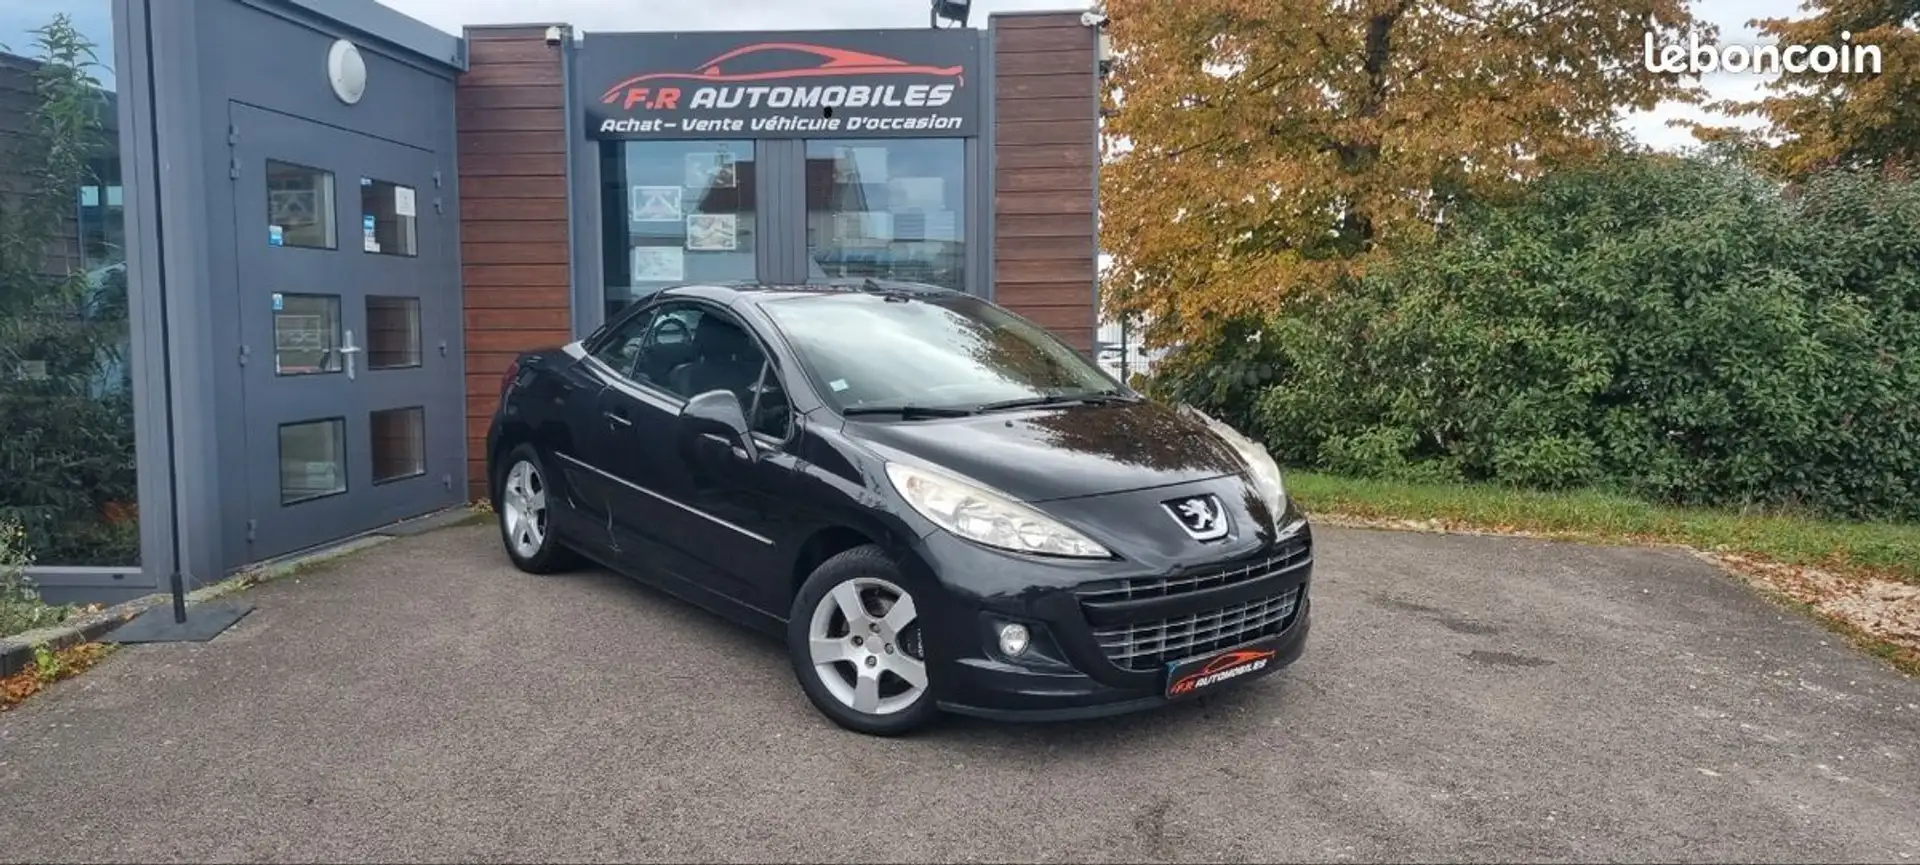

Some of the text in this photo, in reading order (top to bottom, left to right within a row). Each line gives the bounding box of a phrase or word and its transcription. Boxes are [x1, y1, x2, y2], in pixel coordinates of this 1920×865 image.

[623, 84, 955, 110] F.R AUTOMOBILES
[681, 118, 743, 132] Vente
[750, 115, 841, 131] Véhicule
[846, 113, 963, 130] D'occasion
[1195, 658, 1268, 689] AUTOMOBILES
